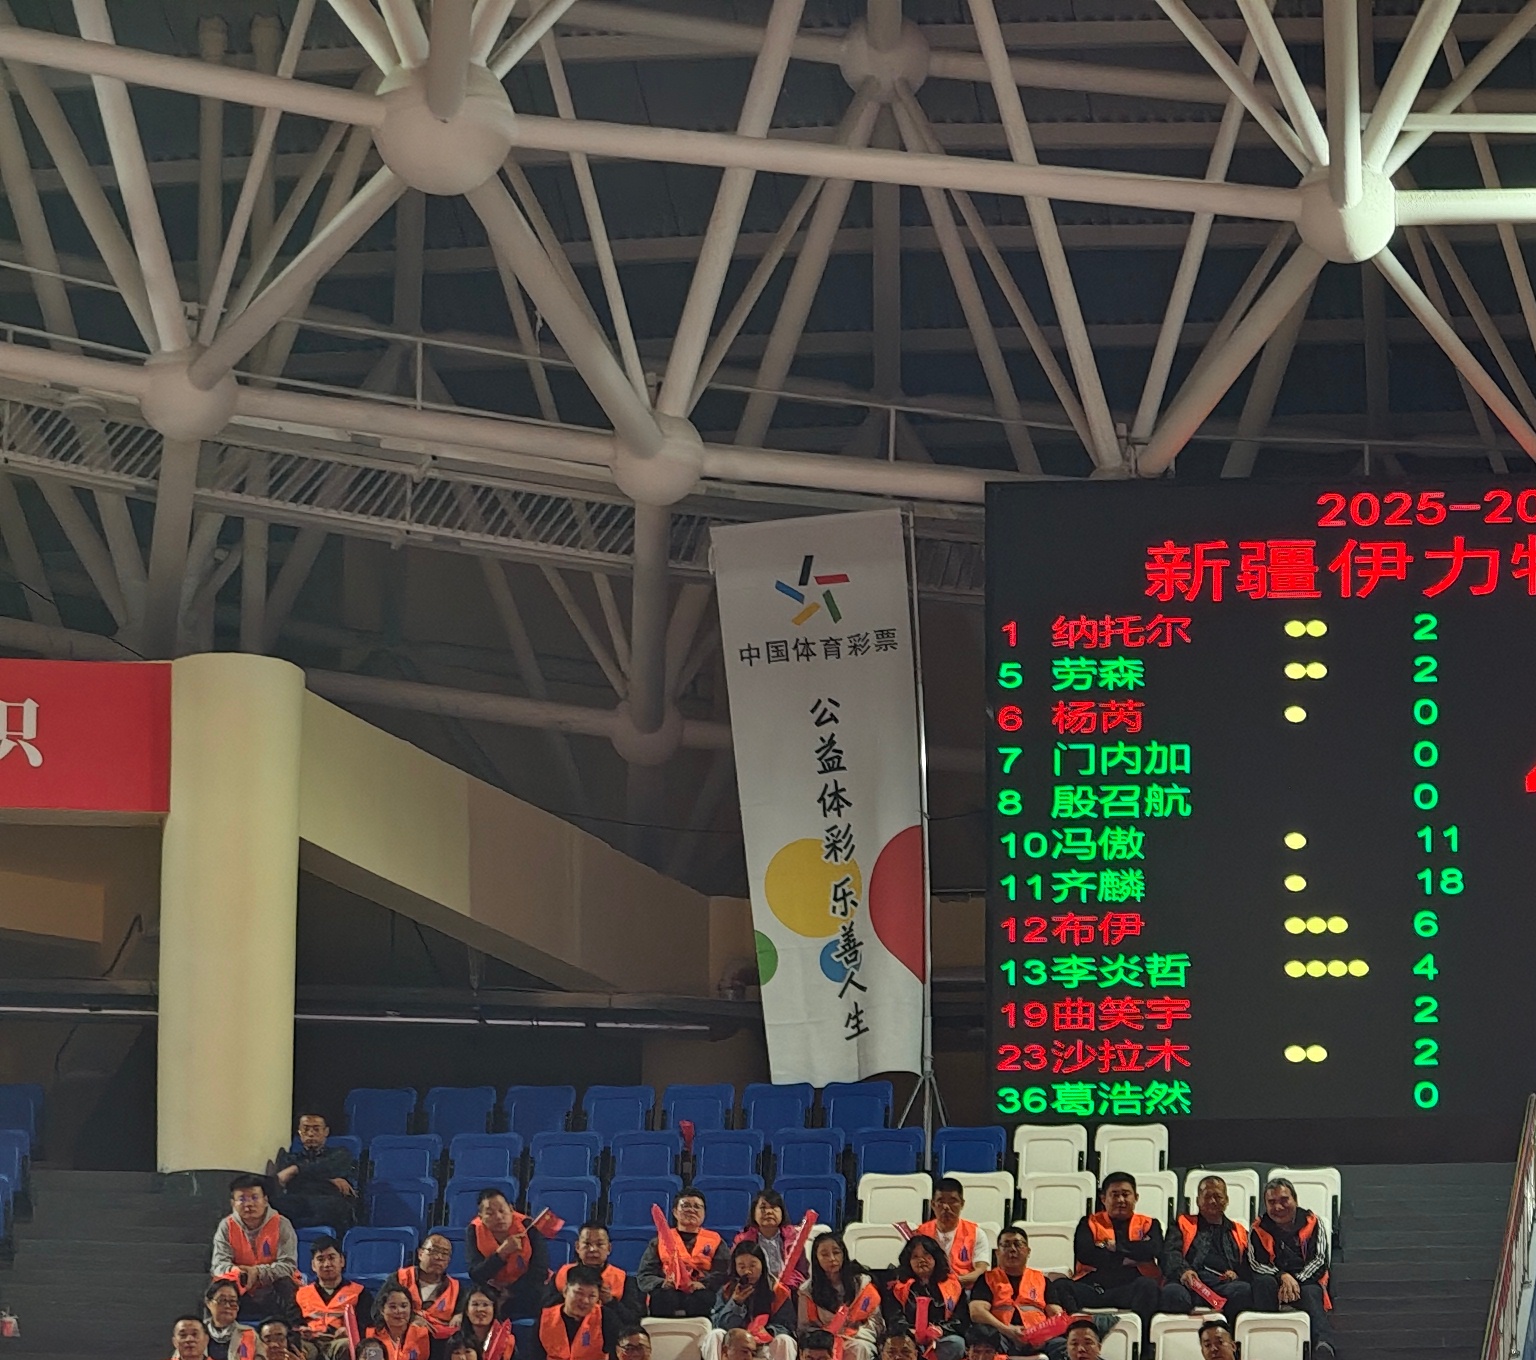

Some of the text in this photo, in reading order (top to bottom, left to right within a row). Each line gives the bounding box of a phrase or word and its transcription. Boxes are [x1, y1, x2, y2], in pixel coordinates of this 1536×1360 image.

[1002, 613, 1437, 649] 1 纳托尔 2
[738, 628, 898, 667] 中国体育彩票
[998, 656, 1437, 691] 5 劳森 2
[997, 705, 1023, 731] 6
[1414, 699, 1438, 725] 0
[998, 740, 1438, 776] 7 门内加 0
[997, 789, 1022, 815] 8
[1414, 783, 1438, 810] 0
[1417, 825, 1457, 852] 11
[1417, 868, 1464, 894] 18
[1414, 910, 1438, 937] 6
[1413, 953, 1438, 980] 4
[1414, 996, 1438, 1022] 2
[1414, 1038, 1438, 1065] 2
[1414, 1081, 1438, 1108] 0
